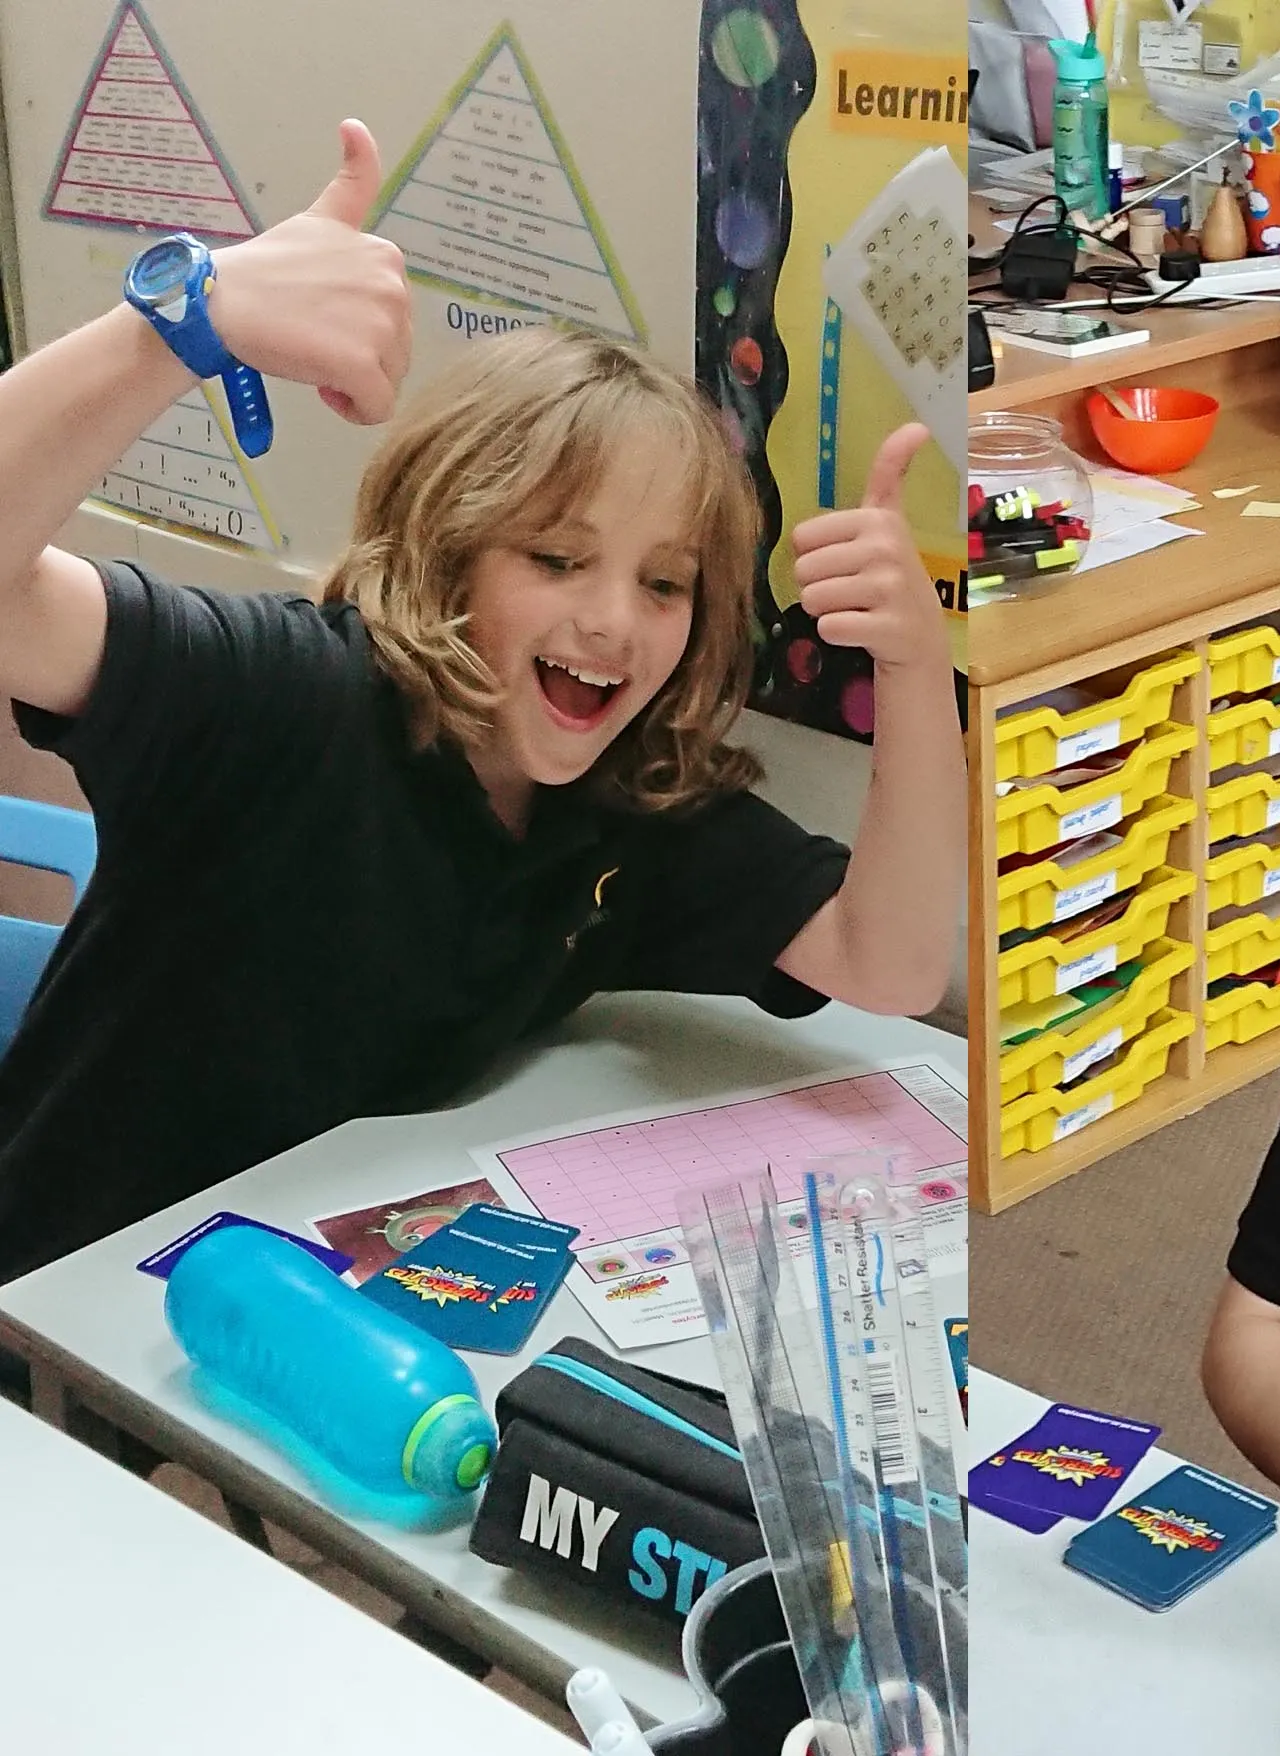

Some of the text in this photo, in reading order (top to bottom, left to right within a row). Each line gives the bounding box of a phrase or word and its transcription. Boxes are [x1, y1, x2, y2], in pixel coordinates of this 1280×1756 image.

[446, 301, 546, 340] Opene
[383, 1266, 492, 1304] SUPERCYTES
[853, 1215, 876, 1331] Shatter Resistant
[1012, 1449, 1123, 1480] SUPERCYTES
[519, 1472, 728, 1617] MY ST
[1117, 1507, 1222, 1553] SUPERCYTES
